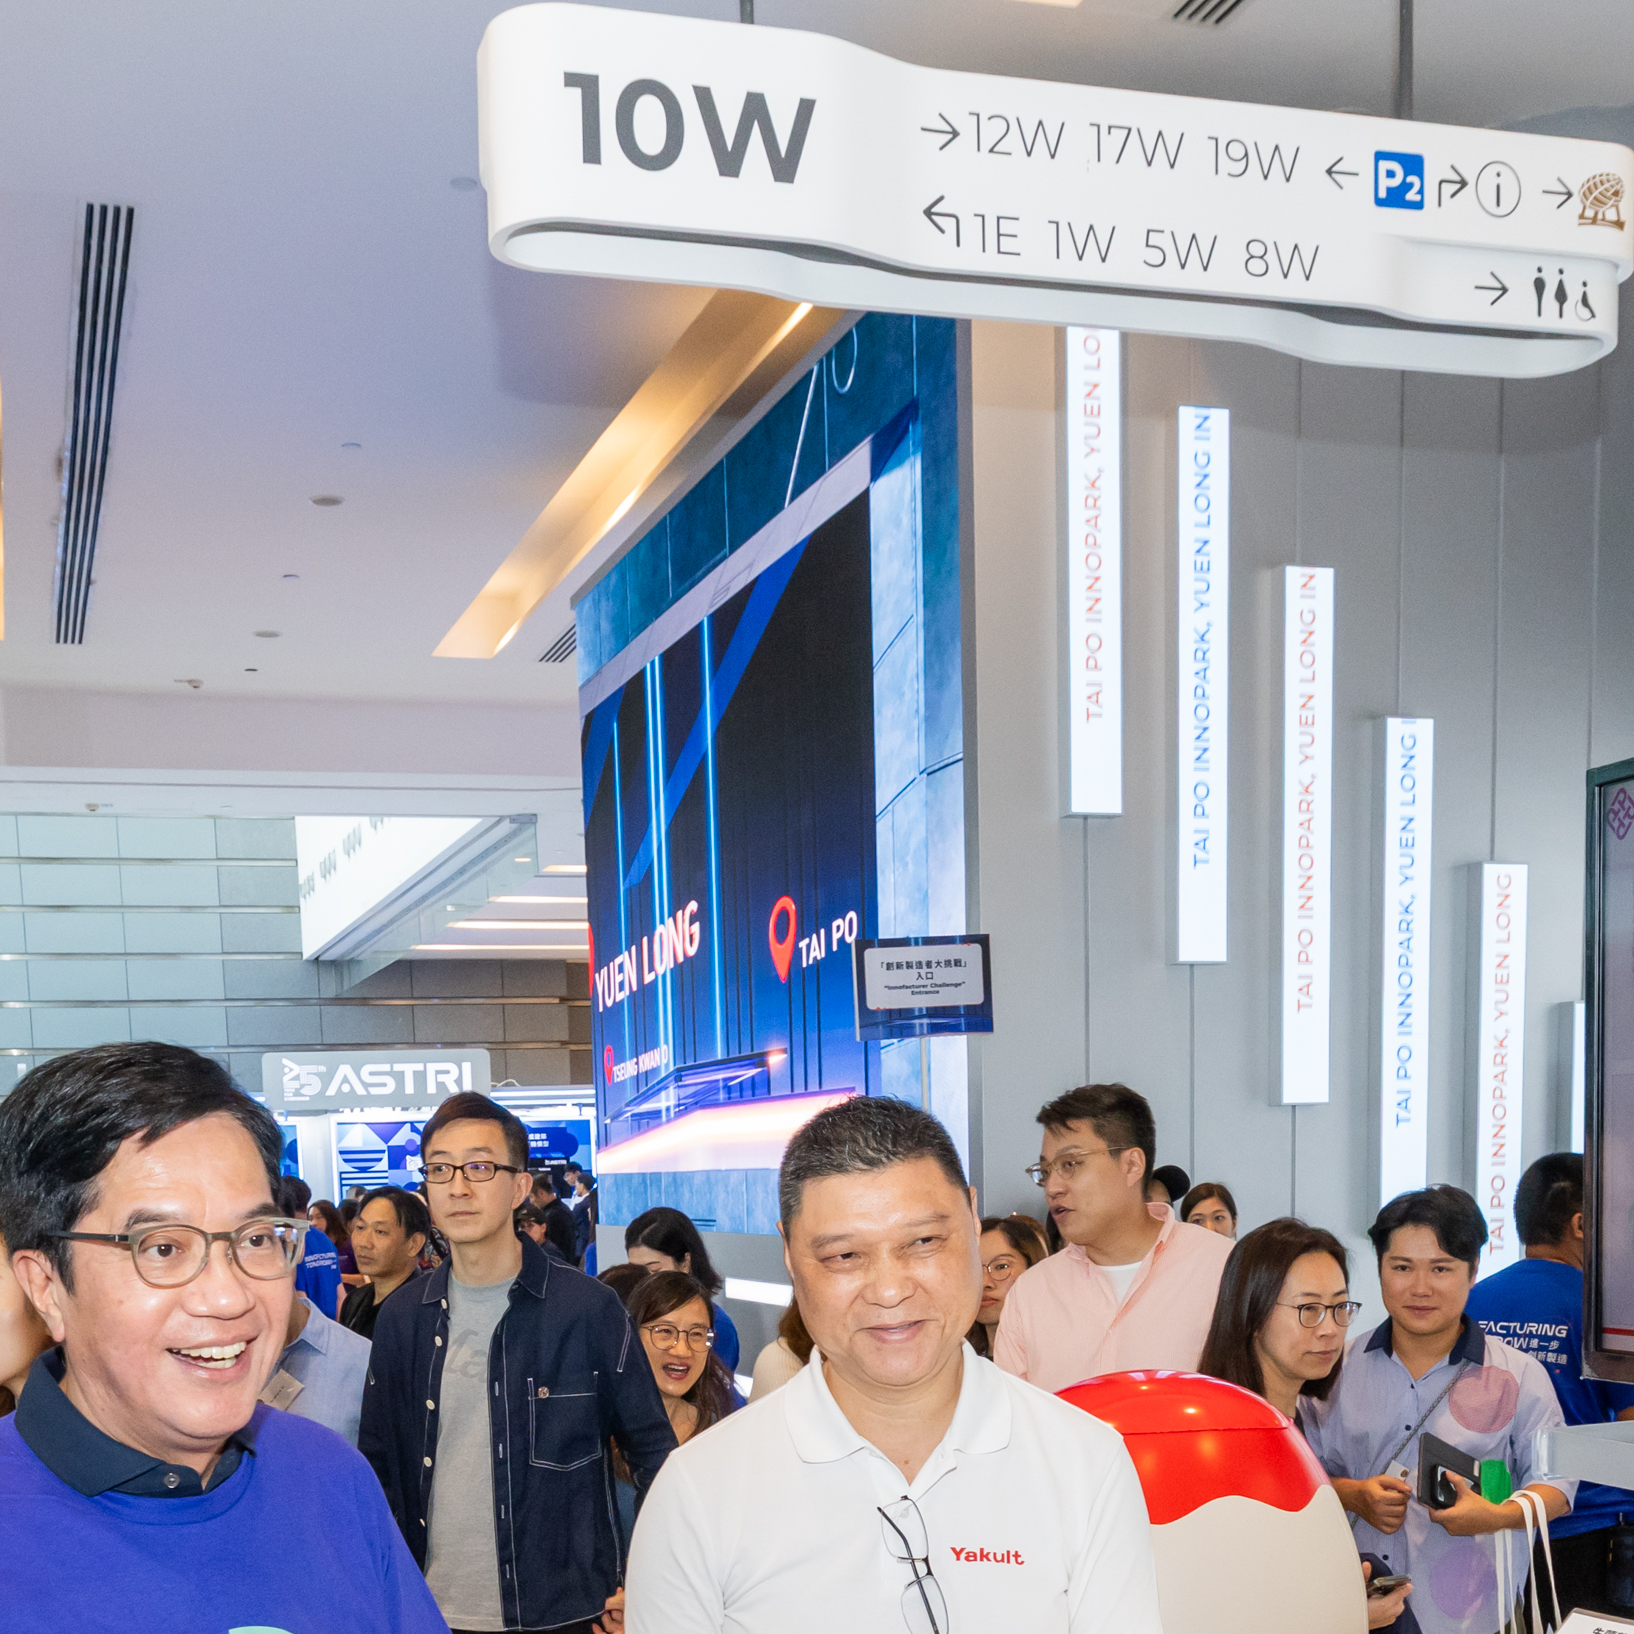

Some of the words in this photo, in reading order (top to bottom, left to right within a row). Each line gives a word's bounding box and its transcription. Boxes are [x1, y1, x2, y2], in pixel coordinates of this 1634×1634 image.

[565, 72, 816, 184] 10W
[969, 111, 1065, 160] 12W
[1090, 123, 1186, 172] 17W
[1208, 136, 1301, 185] 19W
[974, 214, 1021, 258] 1E
[1049, 220, 1116, 265] 1W
[1143, 228, 1218, 274] 5W
[1245, 239, 1321, 283] 8W
[1084, 382, 1101, 460] YUEN
[1194, 450, 1211, 529] LONG
[1194, 537, 1211, 615] YUEN
[1086, 632, 1102, 671] PO
[1299, 608, 1316, 684] LONG
[1087, 681, 1103, 723] TAI
[1298, 693, 1315, 767] YUEN
[1401, 732, 1416, 809] LONG
[1194, 782, 1209, 819] PO
[1193, 825, 1210, 870] TAI
[1400, 815, 1415, 888] YUEN
[1497, 872, 1512, 944] LONG
[595, 944, 638, 1013] YUEN
[642, 900, 701, 986] LONG
[798, 928, 826, 969] TAI
[832, 911, 858, 952] PO
[1297, 928, 1313, 966] PO
[916, 972, 934, 981] 入口
[1297, 971, 1313, 1014] TAI
[1494, 953, 1510, 1024] YUEN
[325, 1062, 472, 1096] ASTRI
[1397, 1045, 1413, 1081] PO
[1396, 1086, 1412, 1129] TAI
[1490, 1174, 1506, 1210] PO
[1489, 1212, 1505, 1256] TAI
[950, 1547, 1025, 1565] Yakult
